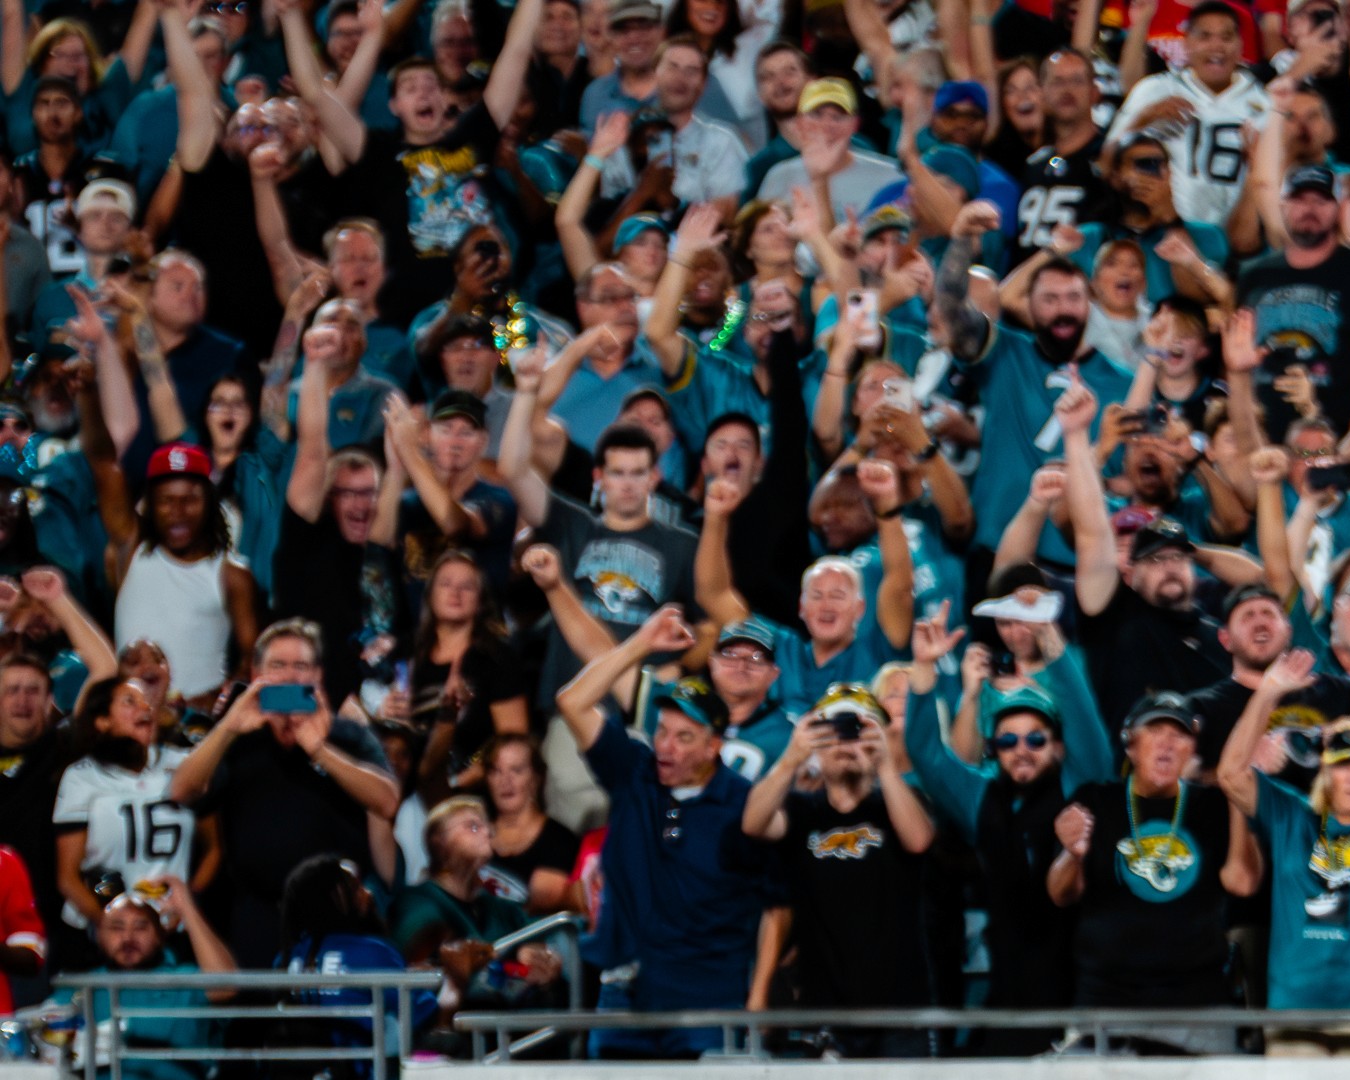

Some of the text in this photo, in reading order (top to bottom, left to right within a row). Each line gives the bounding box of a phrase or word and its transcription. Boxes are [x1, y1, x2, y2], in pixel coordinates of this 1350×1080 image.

[1188, 115, 1247, 184] 16
[1017, 184, 1088, 248] 95
[116, 799, 187, 865] 16
